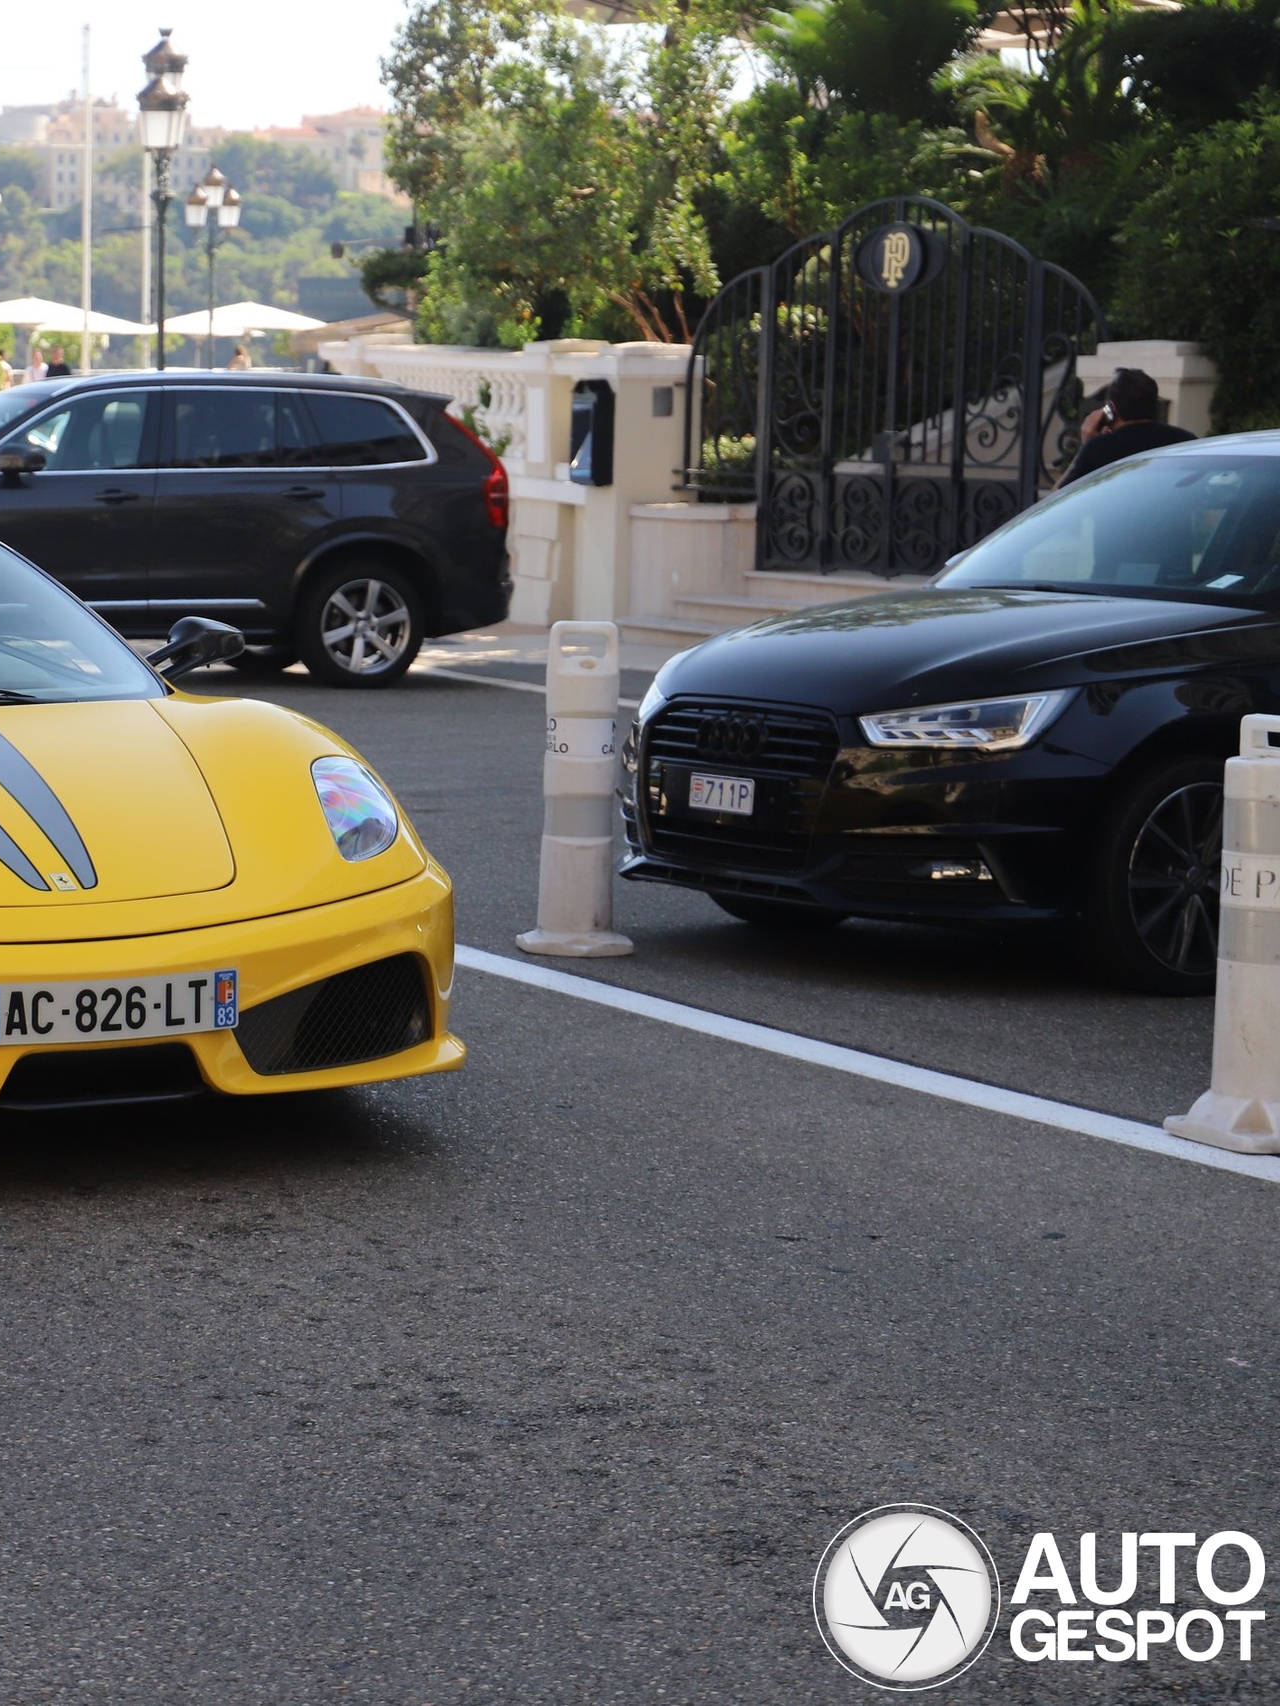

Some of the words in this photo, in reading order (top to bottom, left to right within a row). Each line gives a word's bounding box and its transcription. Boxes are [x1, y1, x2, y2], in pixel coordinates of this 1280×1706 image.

[705, 780, 749, 808] 711P
[1256, 869, 1280, 898] P
[5, 979, 207, 1035] AC-826-LT
[217, 1006, 234, 1026] 83
